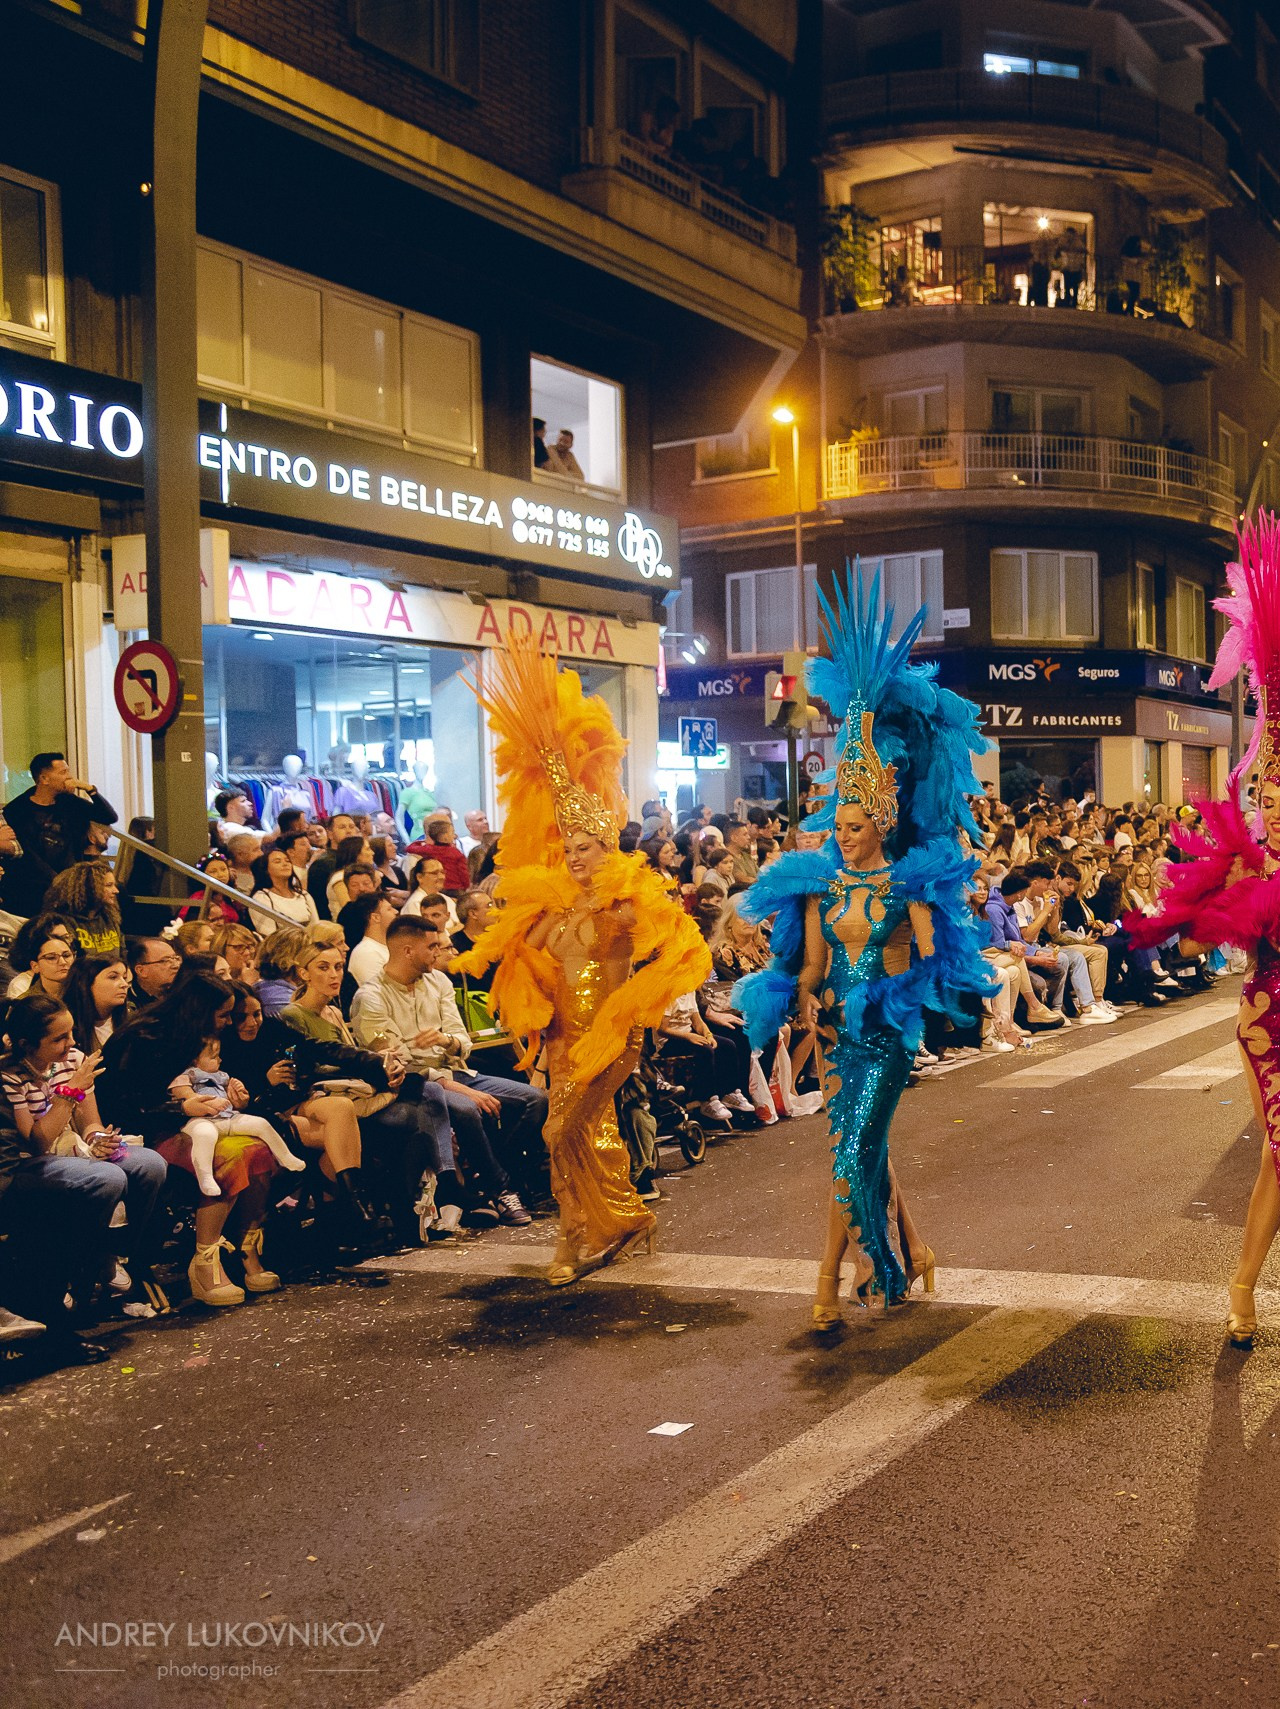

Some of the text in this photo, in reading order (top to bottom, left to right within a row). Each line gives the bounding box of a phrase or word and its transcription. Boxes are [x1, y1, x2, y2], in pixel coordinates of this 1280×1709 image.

[0, 381, 144, 458] RIO
[199, 433, 504, 529] ENTRO DE BELLEZA
[528, 525, 609, 557] 677 725 155
[228, 565, 413, 633] ADARA
[476, 605, 615, 657] ADARA
[989, 664, 1120, 681] MGS Seguros
[1158, 669, 1176, 687] MGS
[698, 679, 734, 697] MGS
[1033, 715, 1122, 726] FABRICANTES
[808, 762, 820, 773] 20
